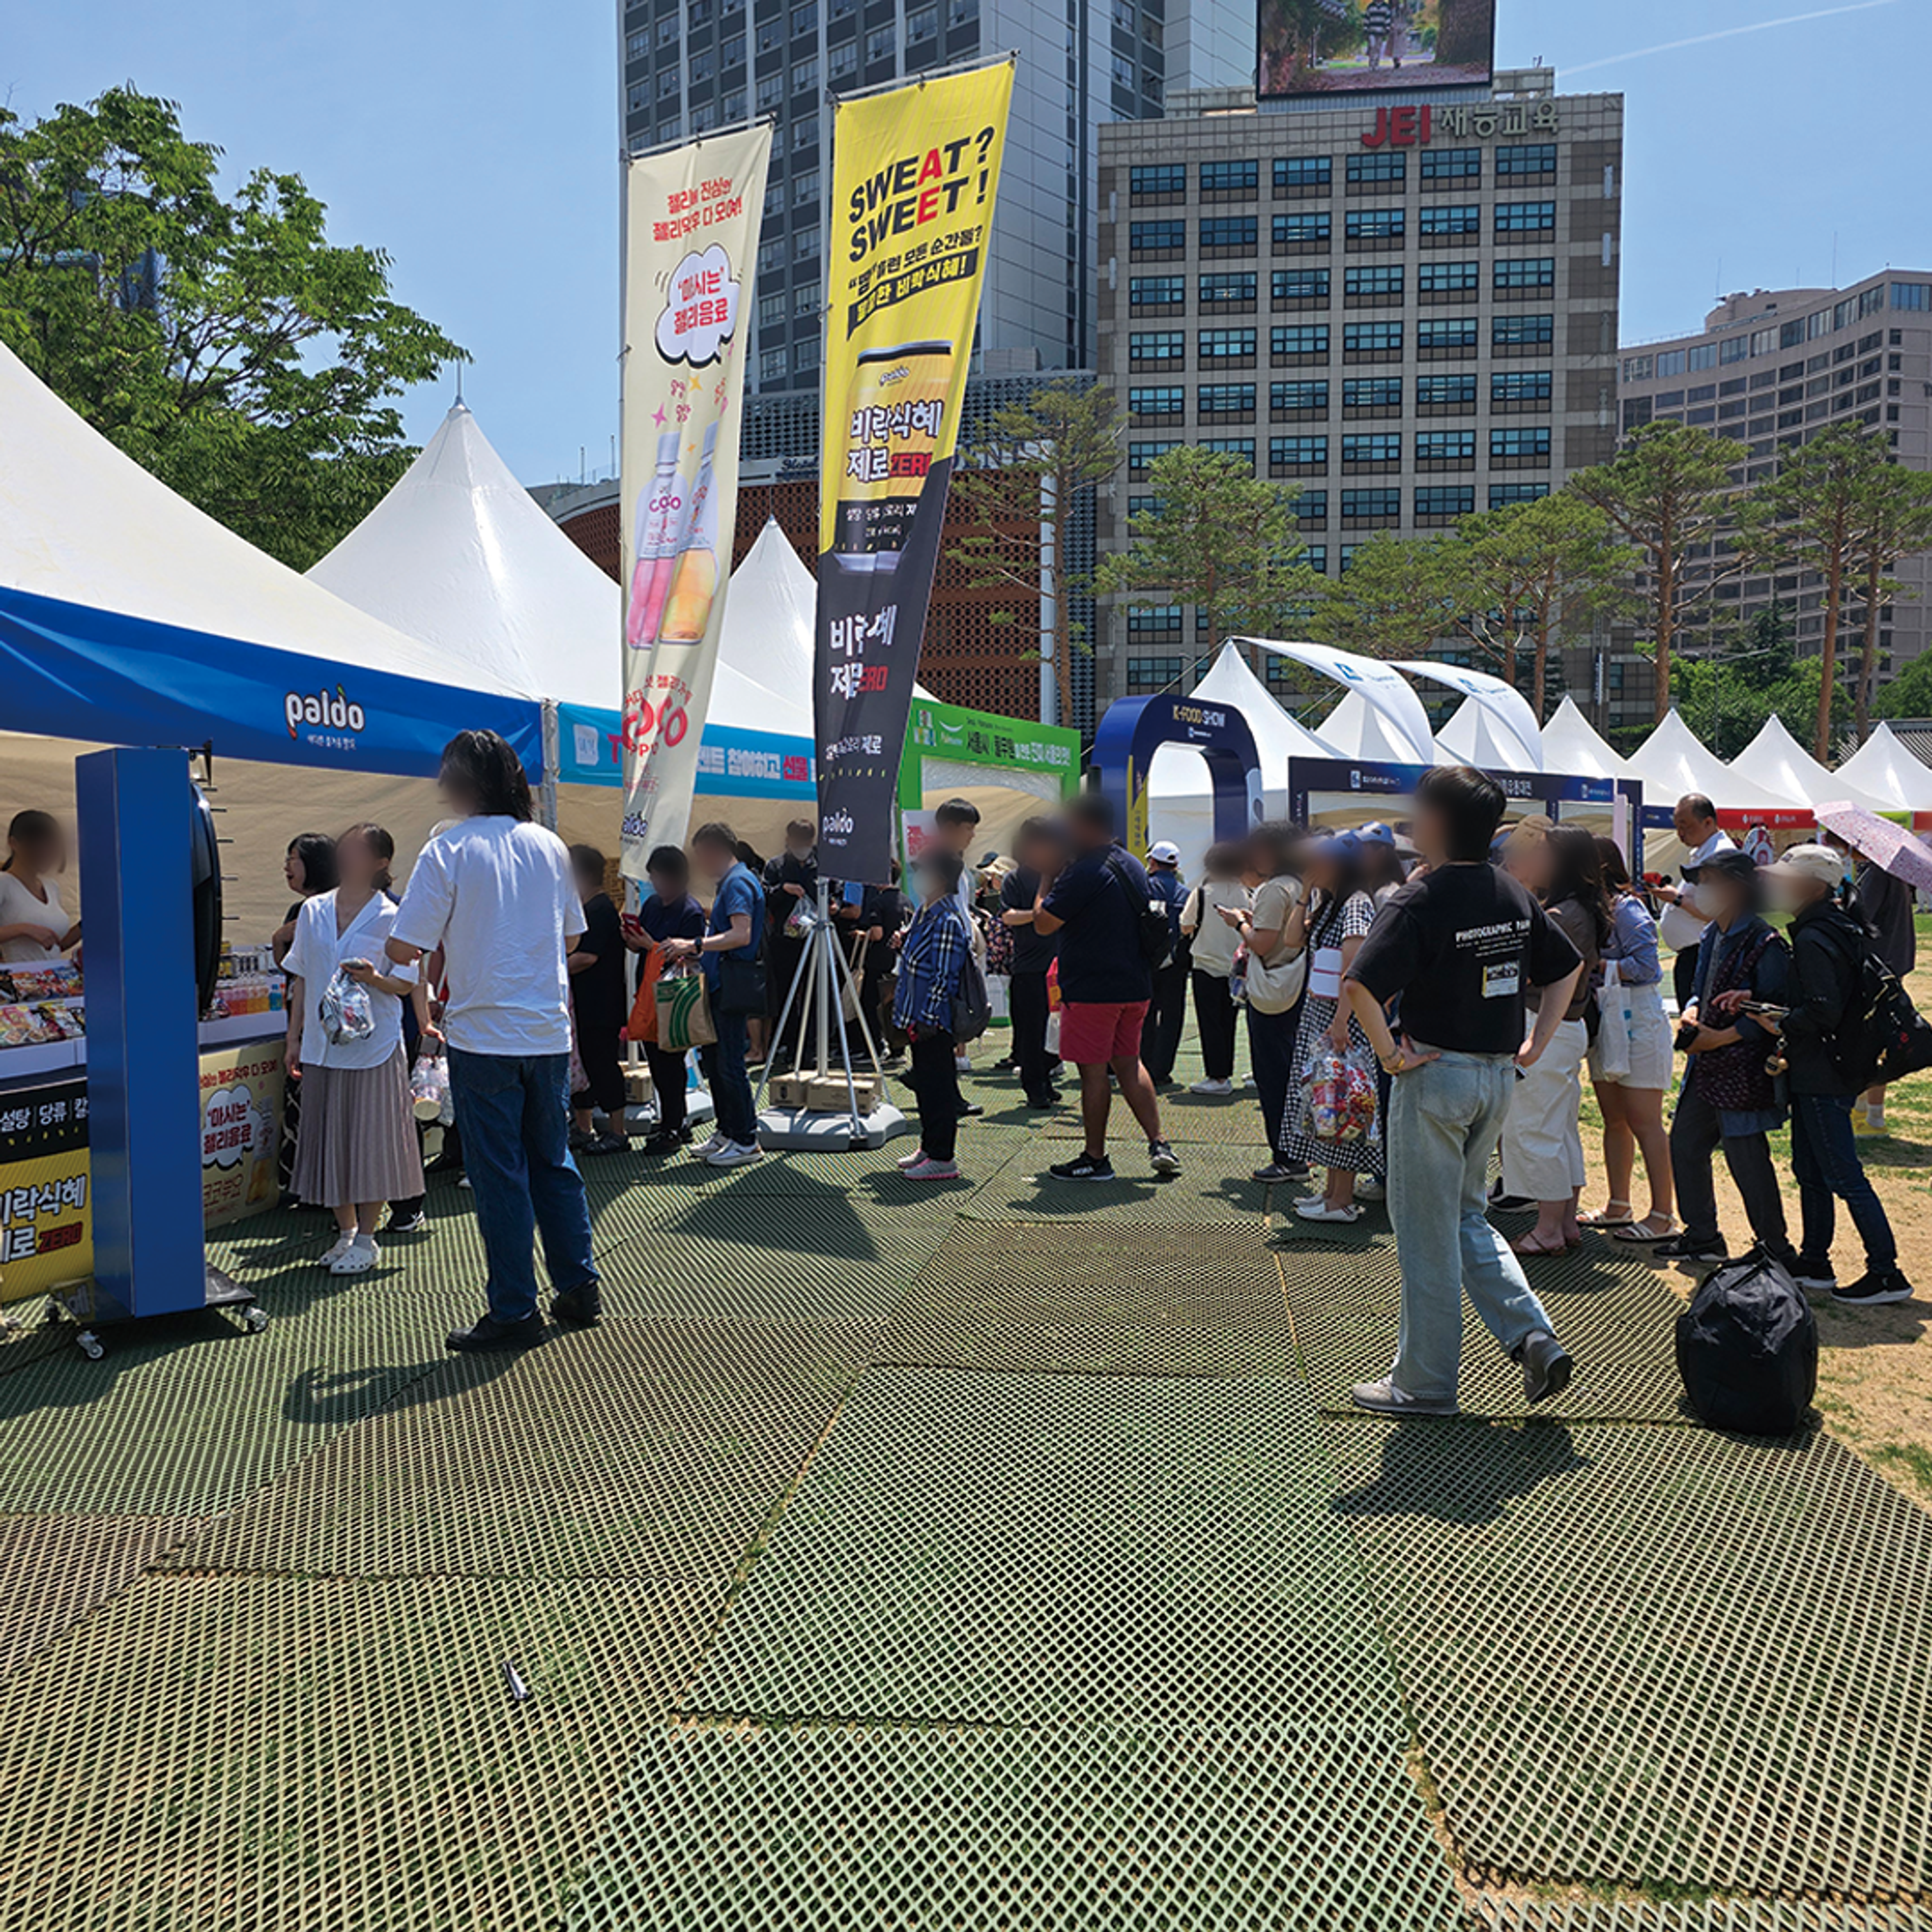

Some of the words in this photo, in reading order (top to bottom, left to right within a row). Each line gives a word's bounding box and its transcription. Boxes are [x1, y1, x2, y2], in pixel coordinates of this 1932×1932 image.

[1361, 103, 1431, 147] JEI
[1440, 100, 1559, 137] 재능교육
[850, 399, 944, 444] 비락식혜
[284, 683, 365, 741] paldo
[1202, 710, 1226, 727] SHOW
[783, 755, 809, 782] 선물
[0, 1108, 31, 1133] 설탕
[39, 1101, 67, 1126] 당류
[38, 1222, 83, 1254] ZERO
